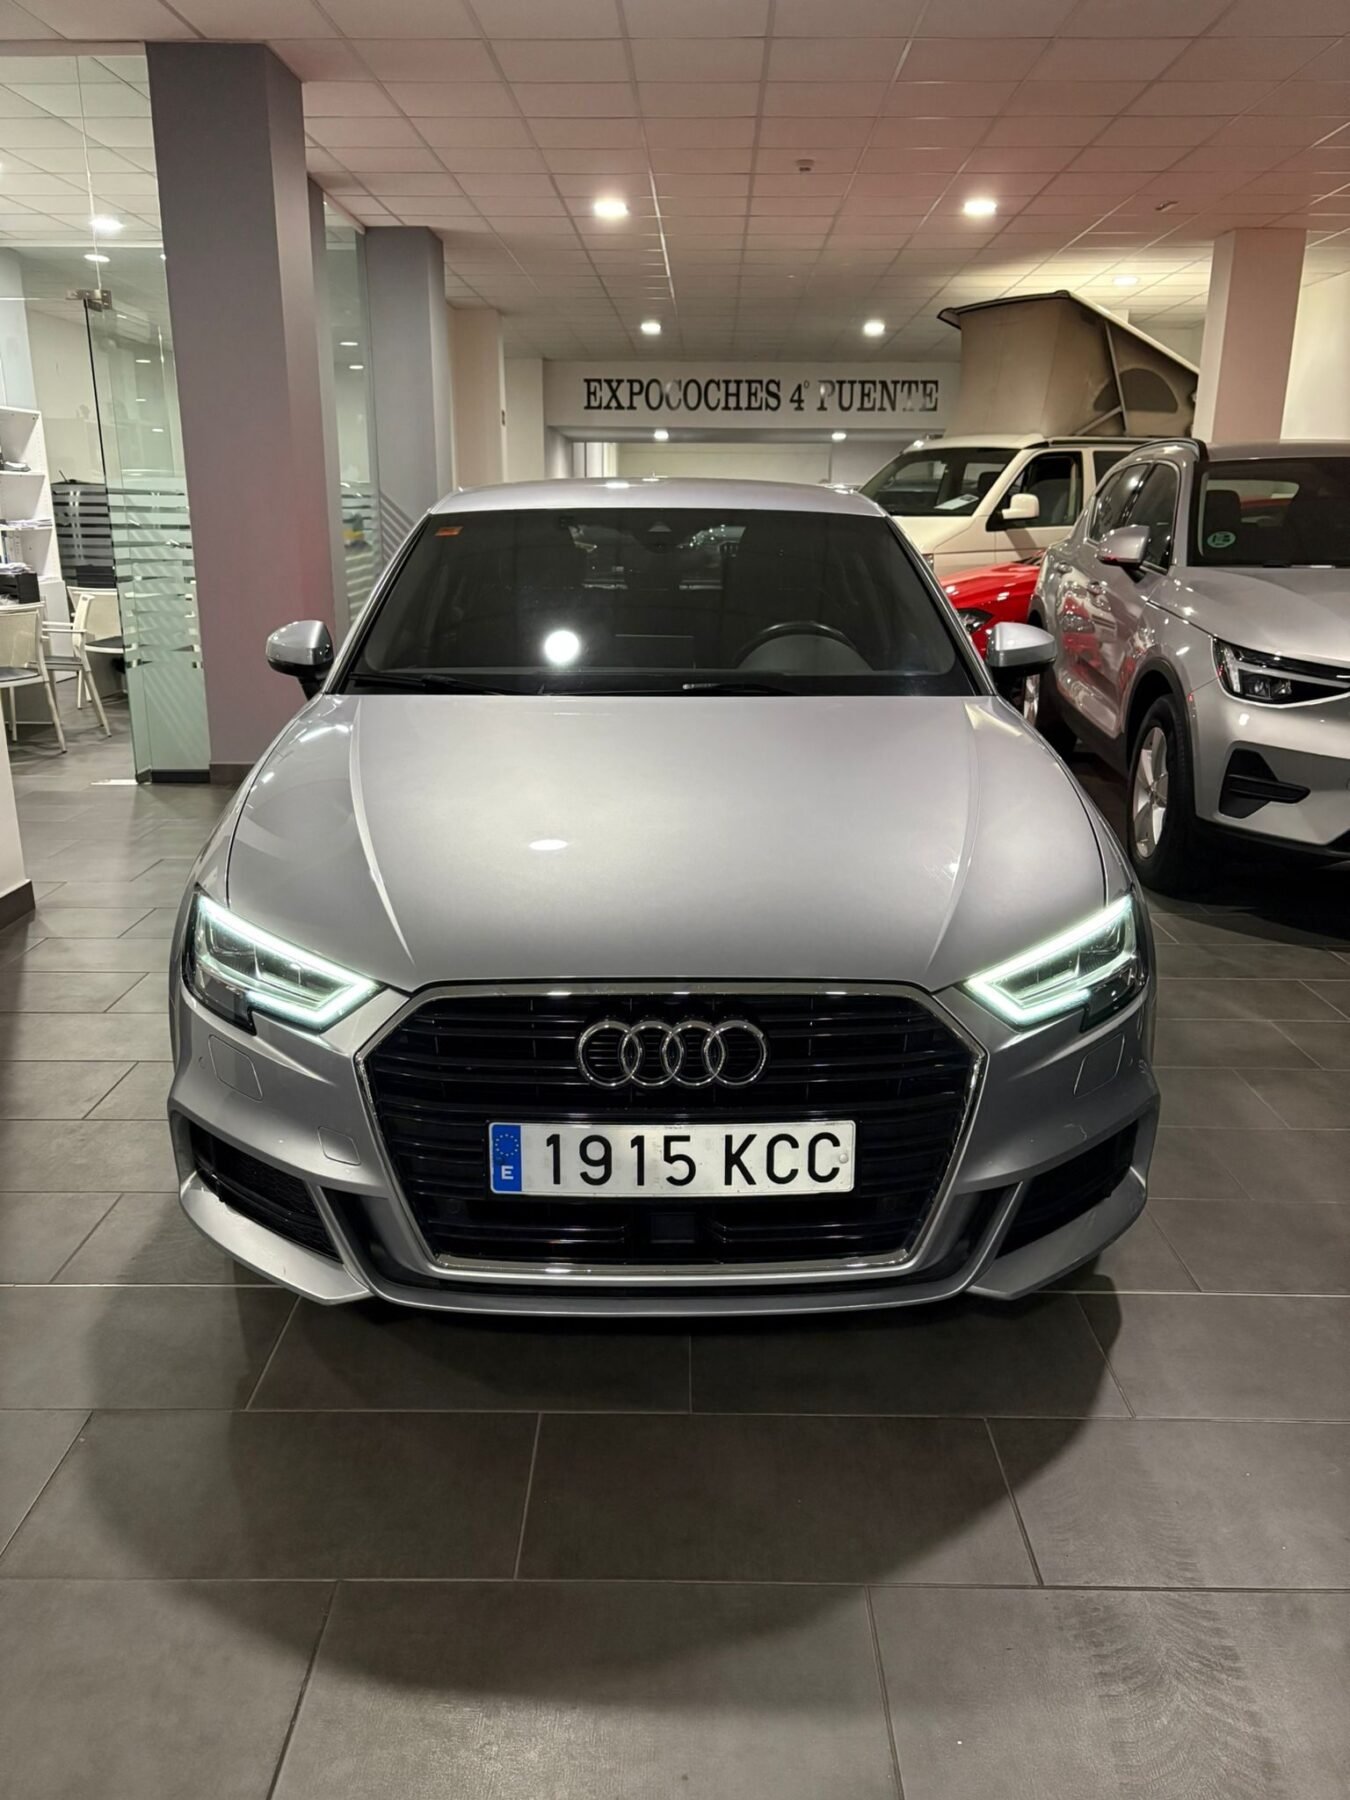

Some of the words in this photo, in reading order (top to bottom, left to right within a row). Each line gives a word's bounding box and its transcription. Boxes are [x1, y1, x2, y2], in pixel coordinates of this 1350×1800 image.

[583, 378, 781, 411] EXPOCOCHES
[816, 379, 939, 411] PUENTE
[500, 1165, 514, 1180] E
[545, 1132, 697, 1187] 1915
[723, 1131, 841, 1186] KCC
